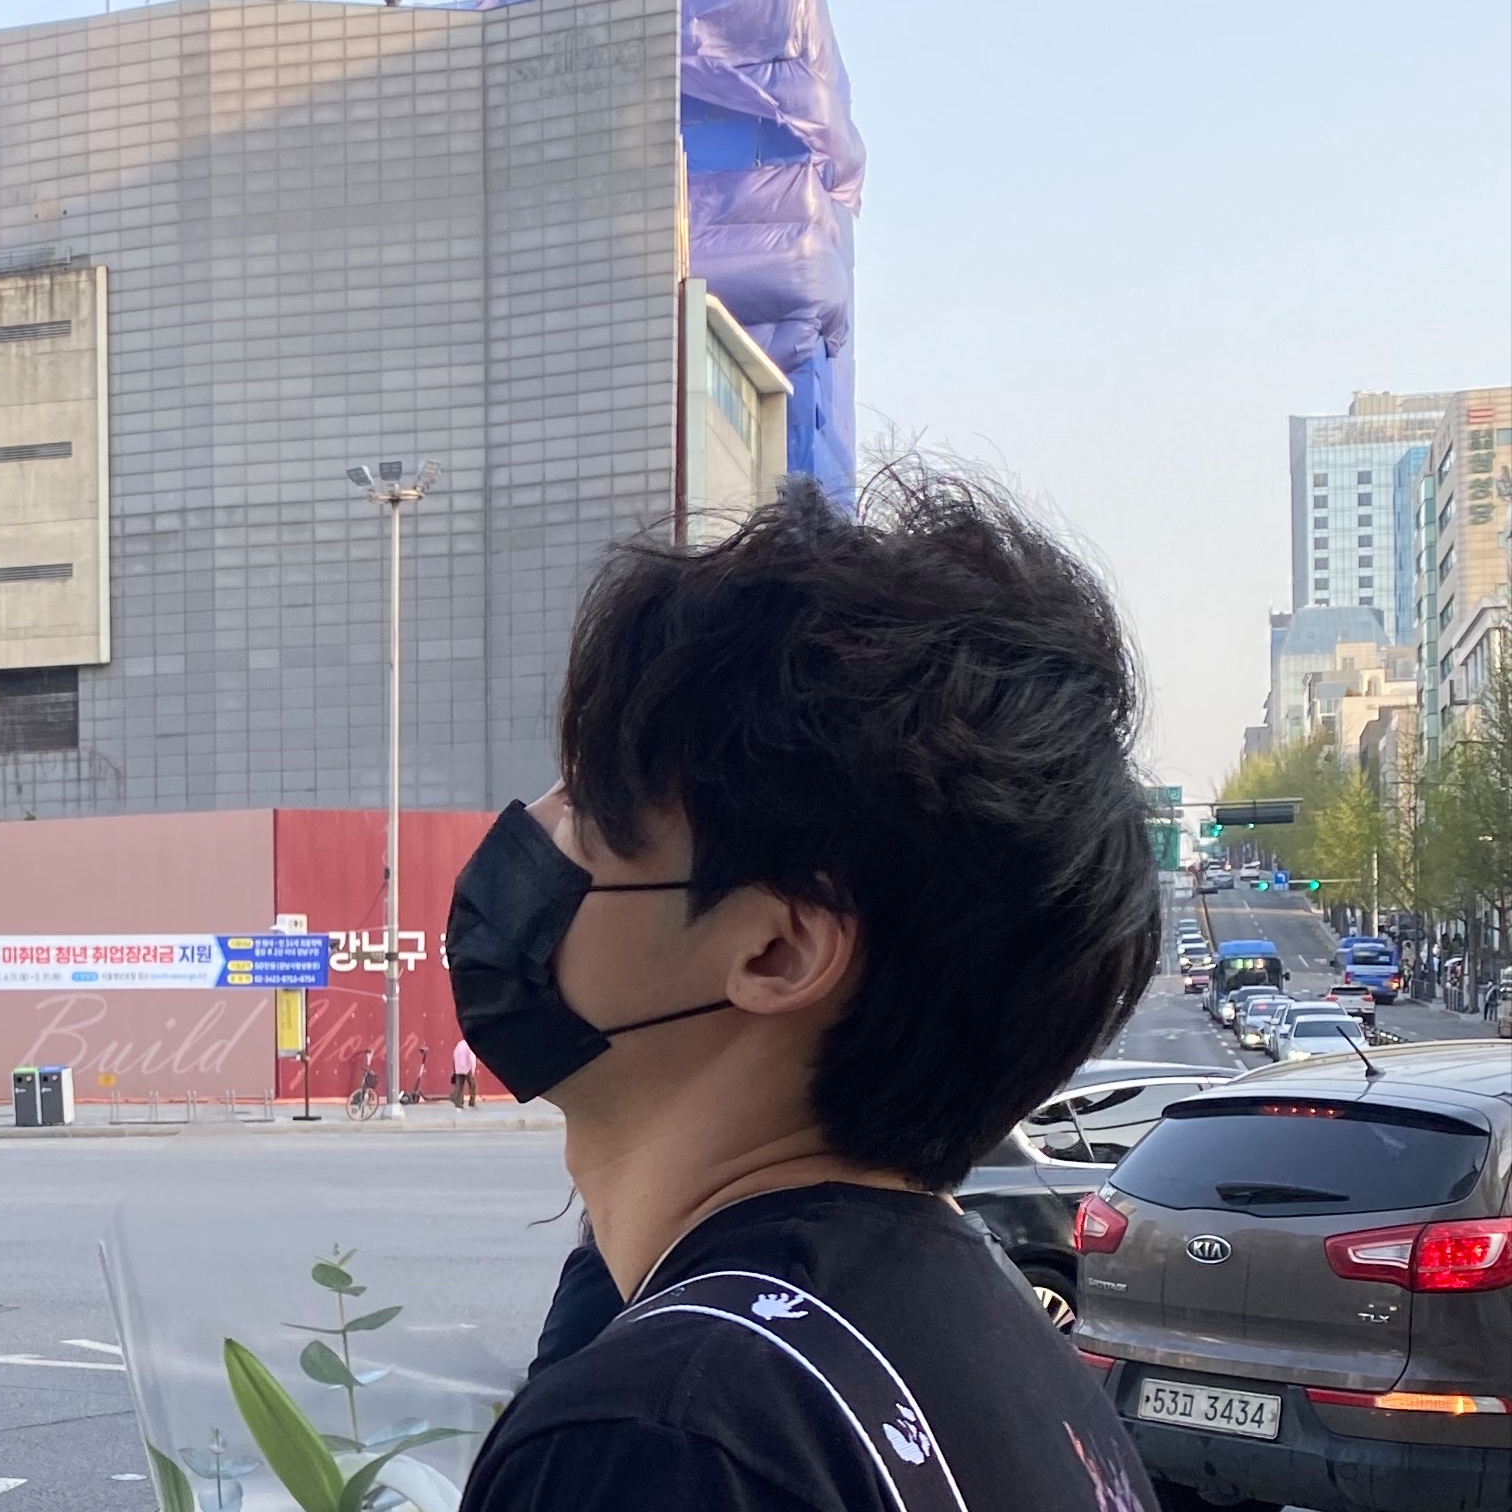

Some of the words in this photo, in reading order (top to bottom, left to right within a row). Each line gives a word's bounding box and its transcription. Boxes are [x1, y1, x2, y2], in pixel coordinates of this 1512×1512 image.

[2, 945, 51, 965] 미취업
[56, 945, 88, 965] 청년
[92, 944, 175, 965] 취업장려금
[179, 944, 212, 965] 지원
[329, 931, 427, 971] 강남구
[18, 992, 269, 1077] Build
[1192, 1241, 1223, 1260] KIA
[1152, 1388, 1195, 1418] 53고
[1205, 1395, 1266, 1430] 3434
